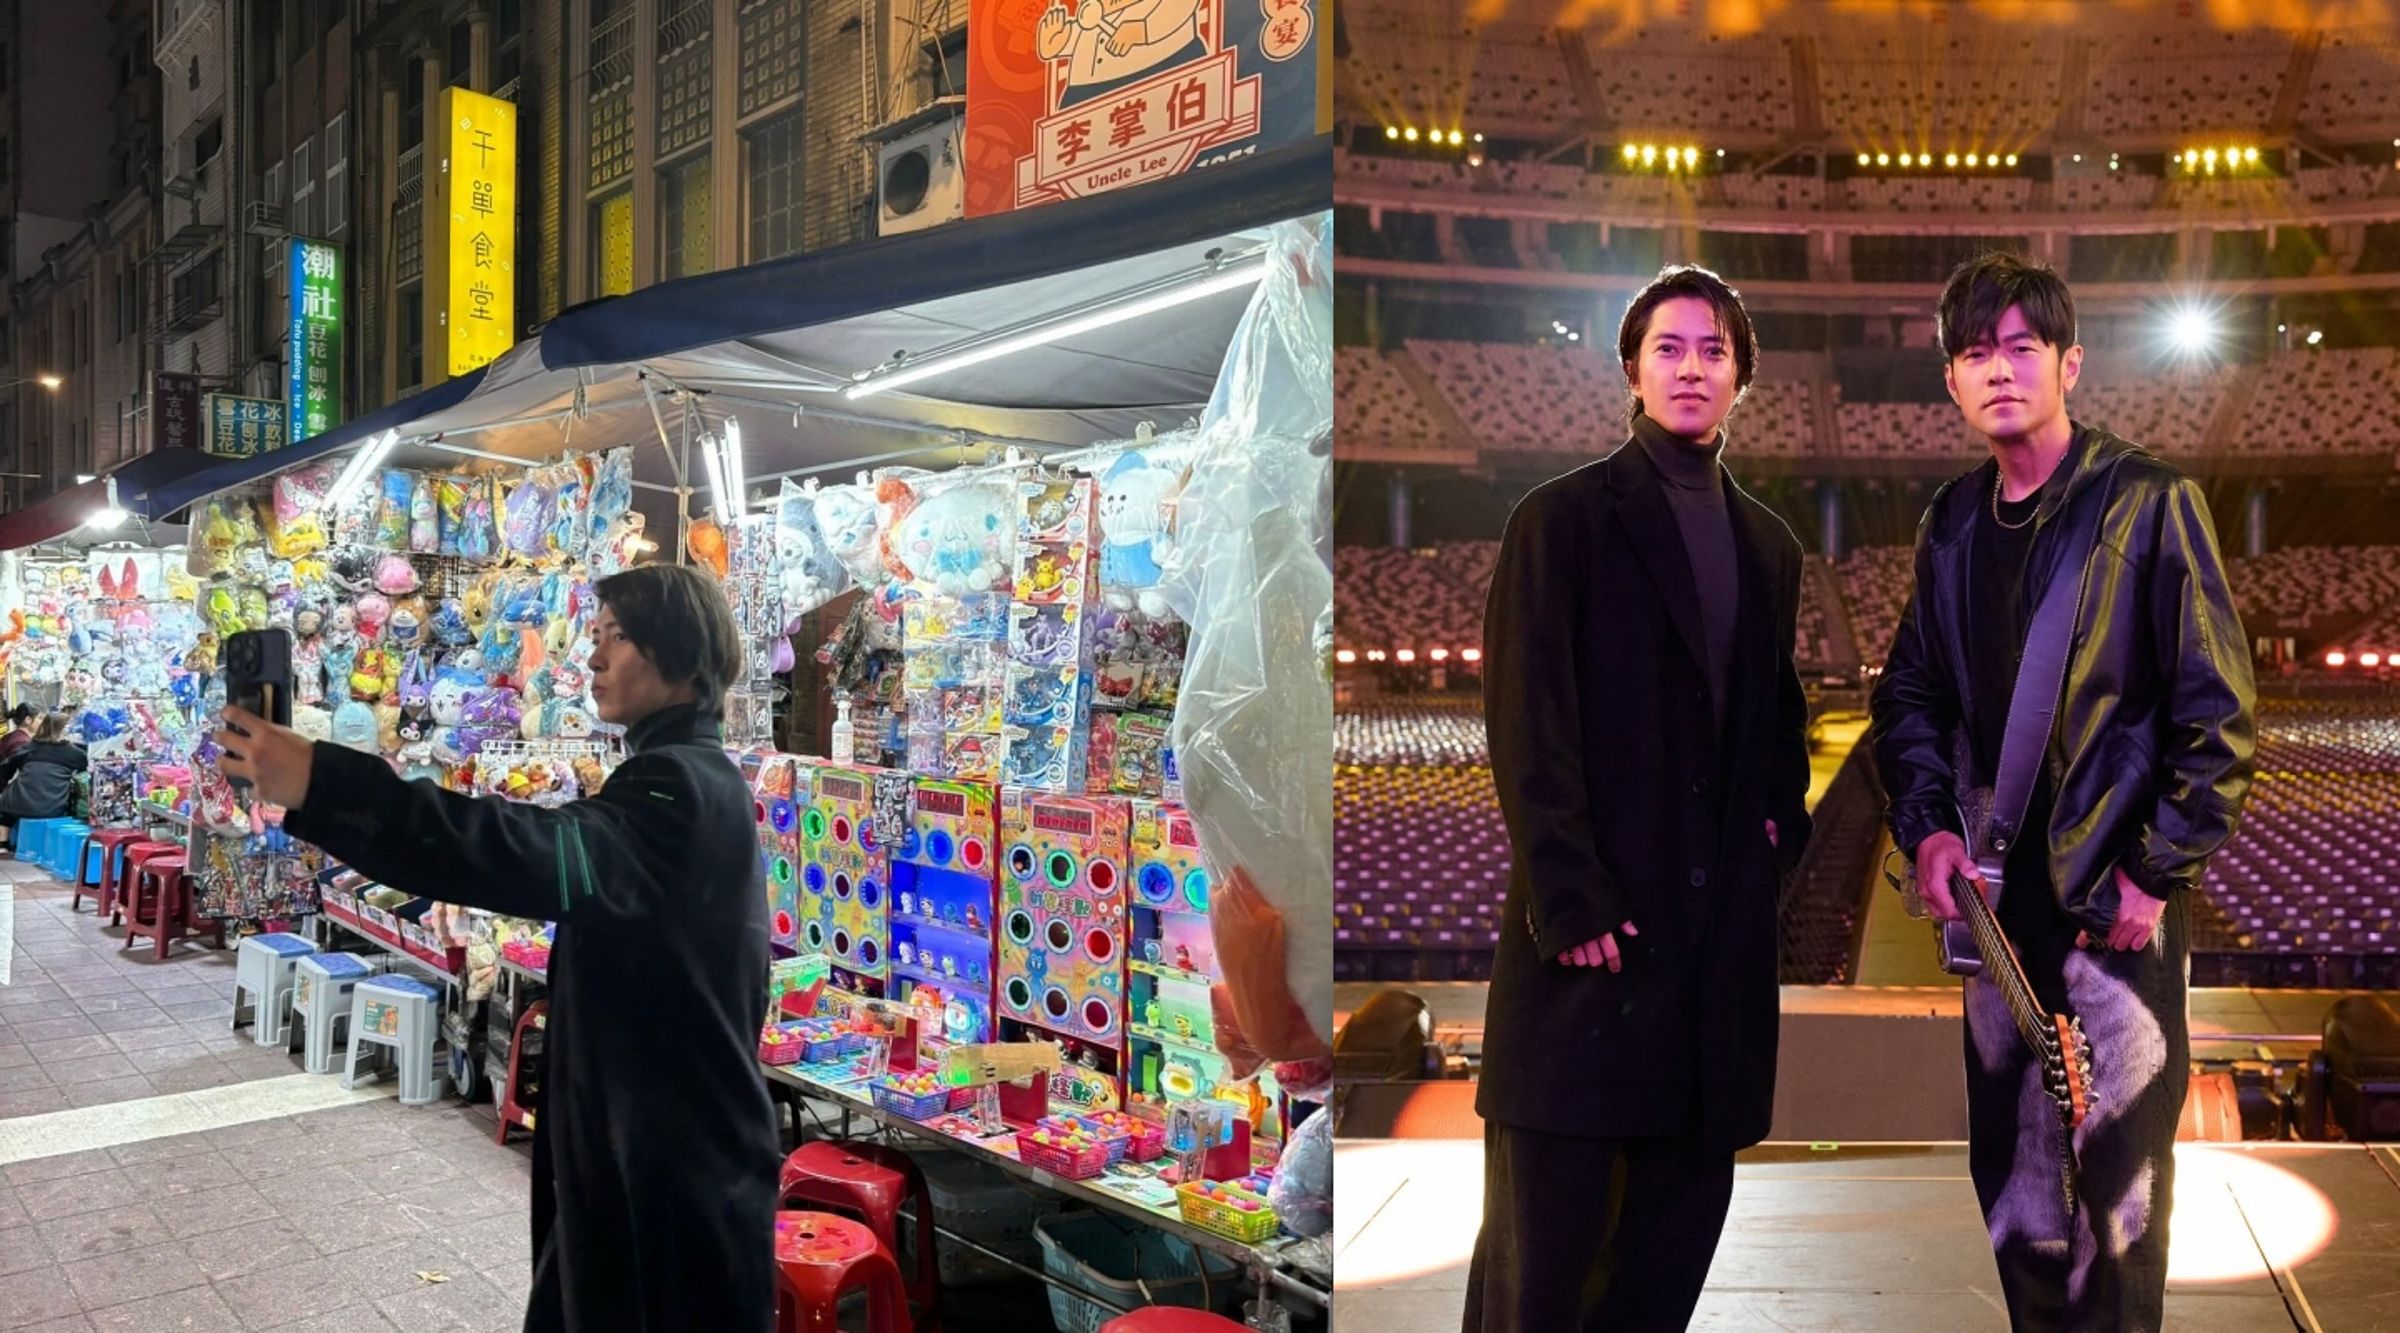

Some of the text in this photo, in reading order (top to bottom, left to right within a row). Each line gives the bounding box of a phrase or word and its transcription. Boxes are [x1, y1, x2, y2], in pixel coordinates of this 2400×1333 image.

[1056, 77, 1206, 167] 李掌伯
[1087, 154, 1168, 190] Uncle Lee
[301, 244, 337, 321] 潮社
[216, 398, 283, 421] 雪花冰
